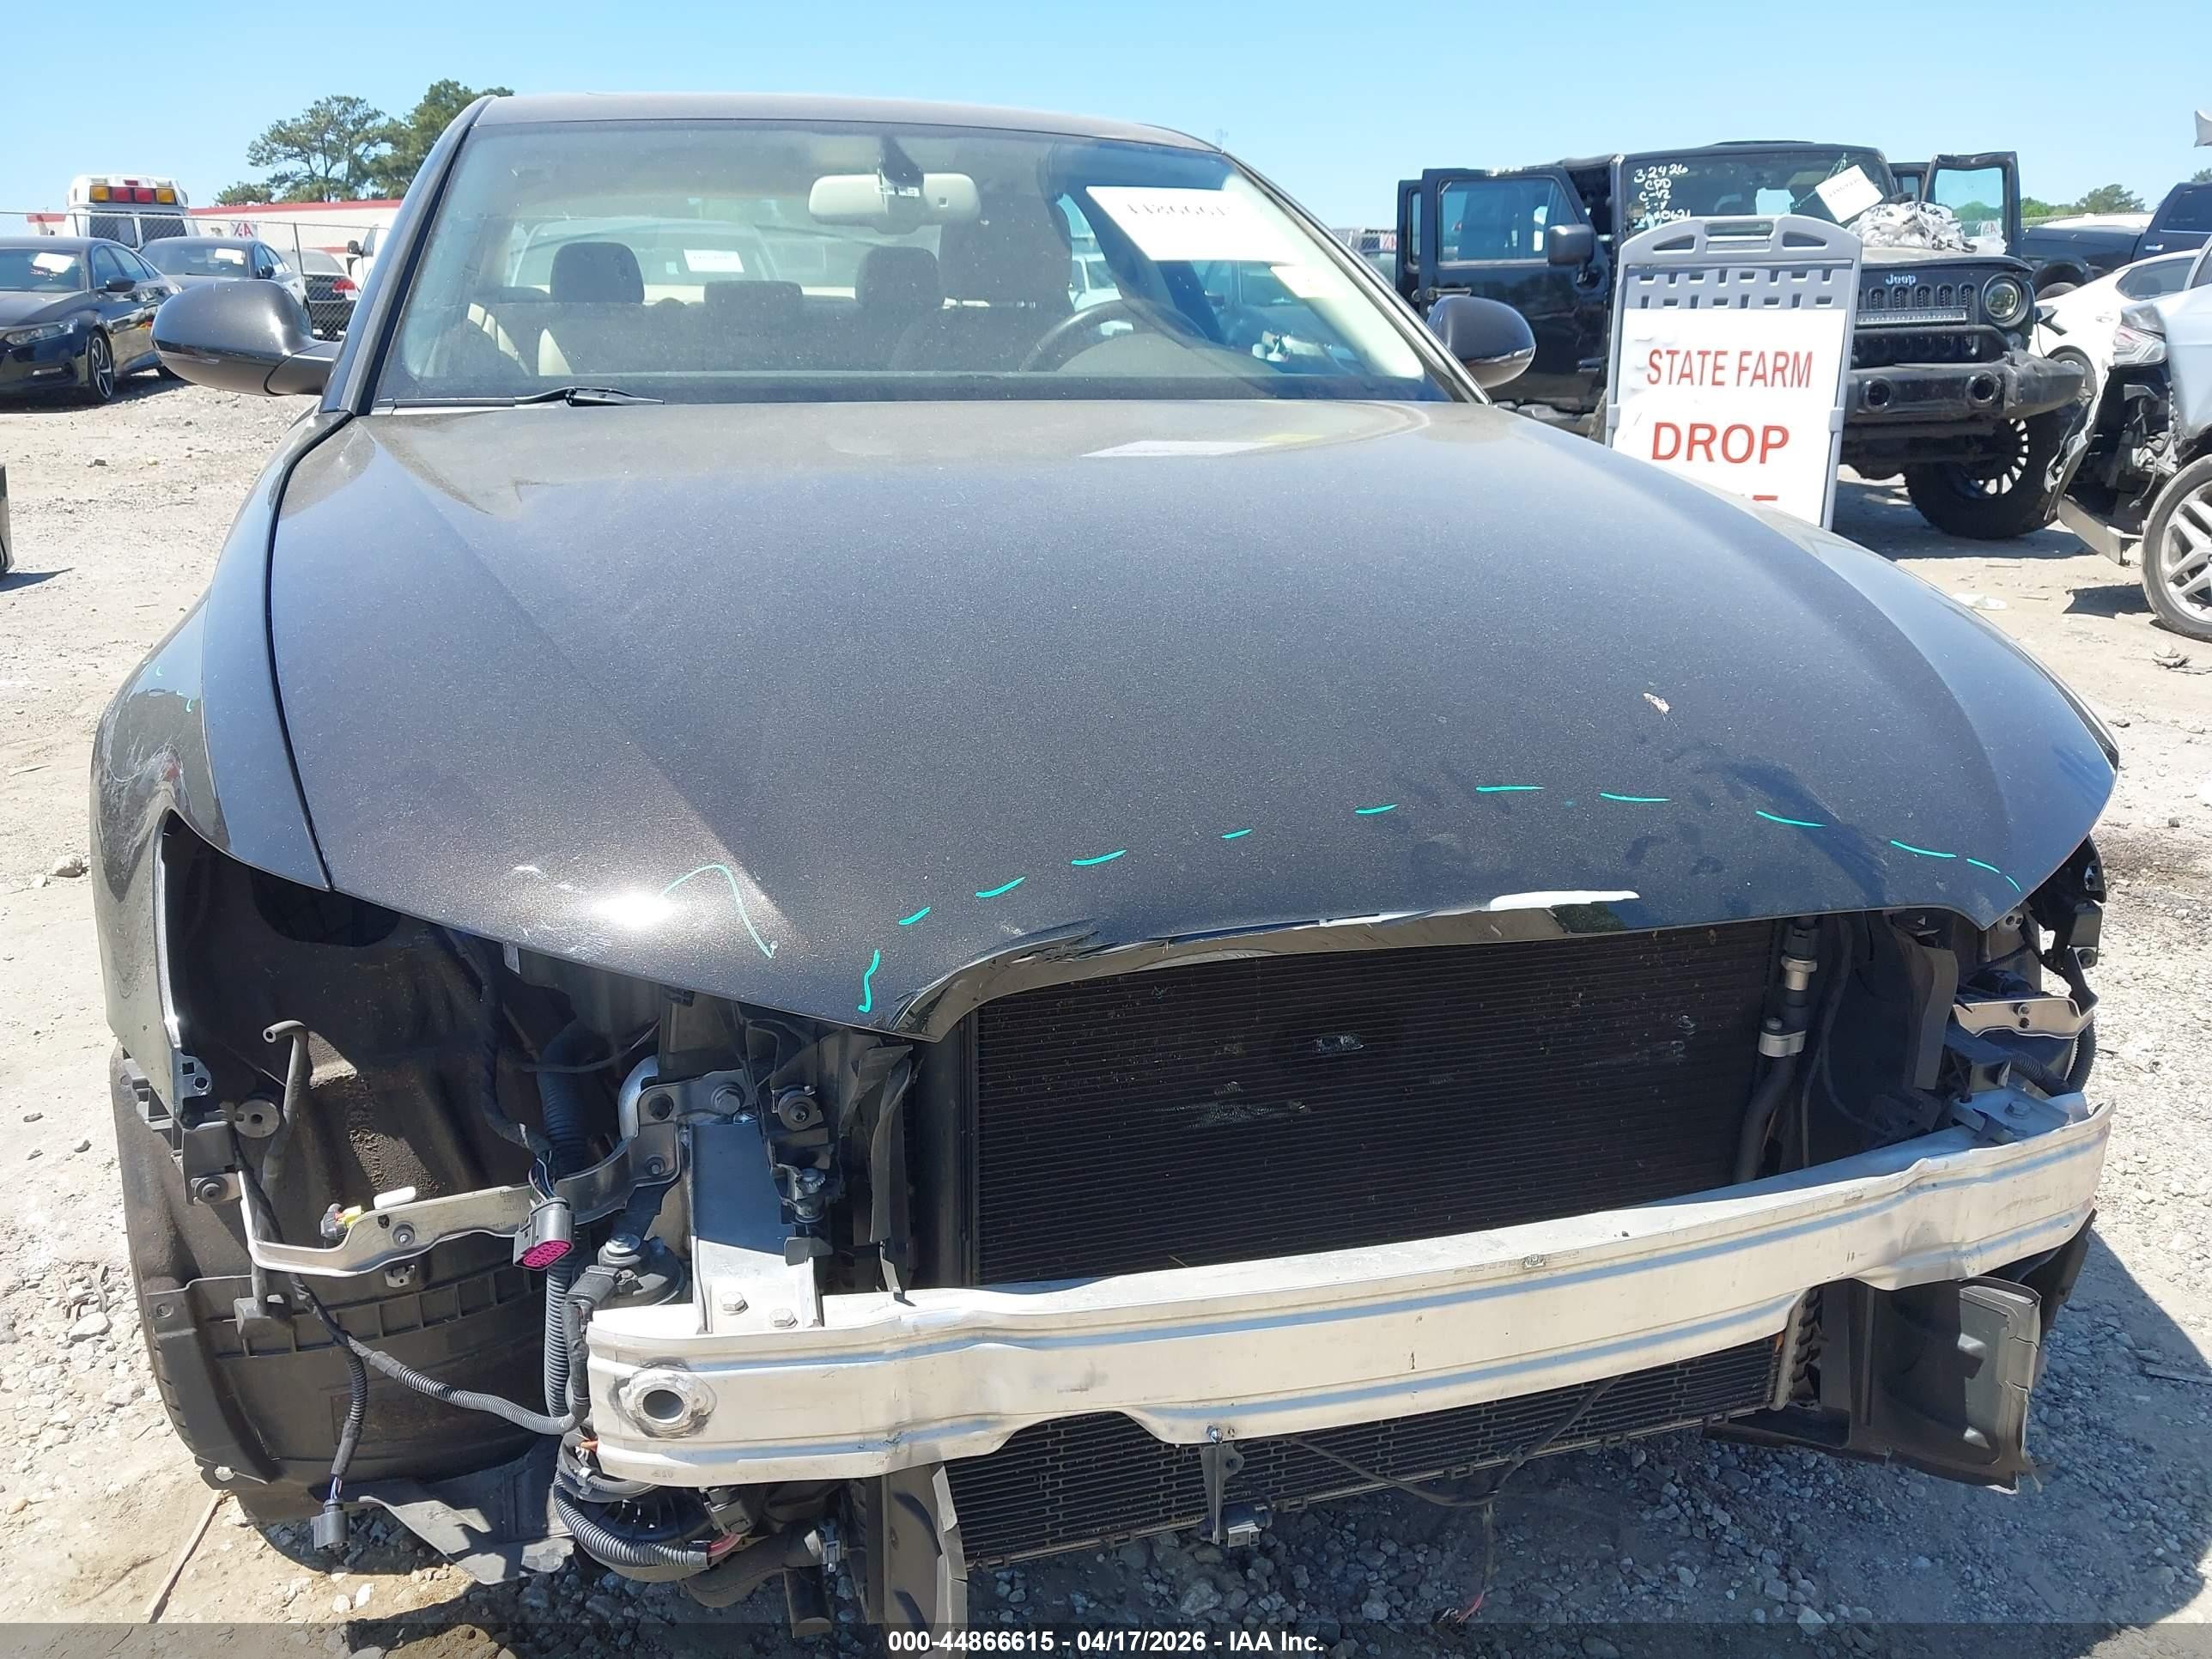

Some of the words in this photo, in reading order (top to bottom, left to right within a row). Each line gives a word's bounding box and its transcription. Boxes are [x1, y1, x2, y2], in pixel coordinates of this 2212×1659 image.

[1886, 274, 1917, 286] Jeep
[1647, 349, 1729, 386] STATE
[1736, 349, 1813, 388] FARM
[1651, 422, 1790, 465] DROP
